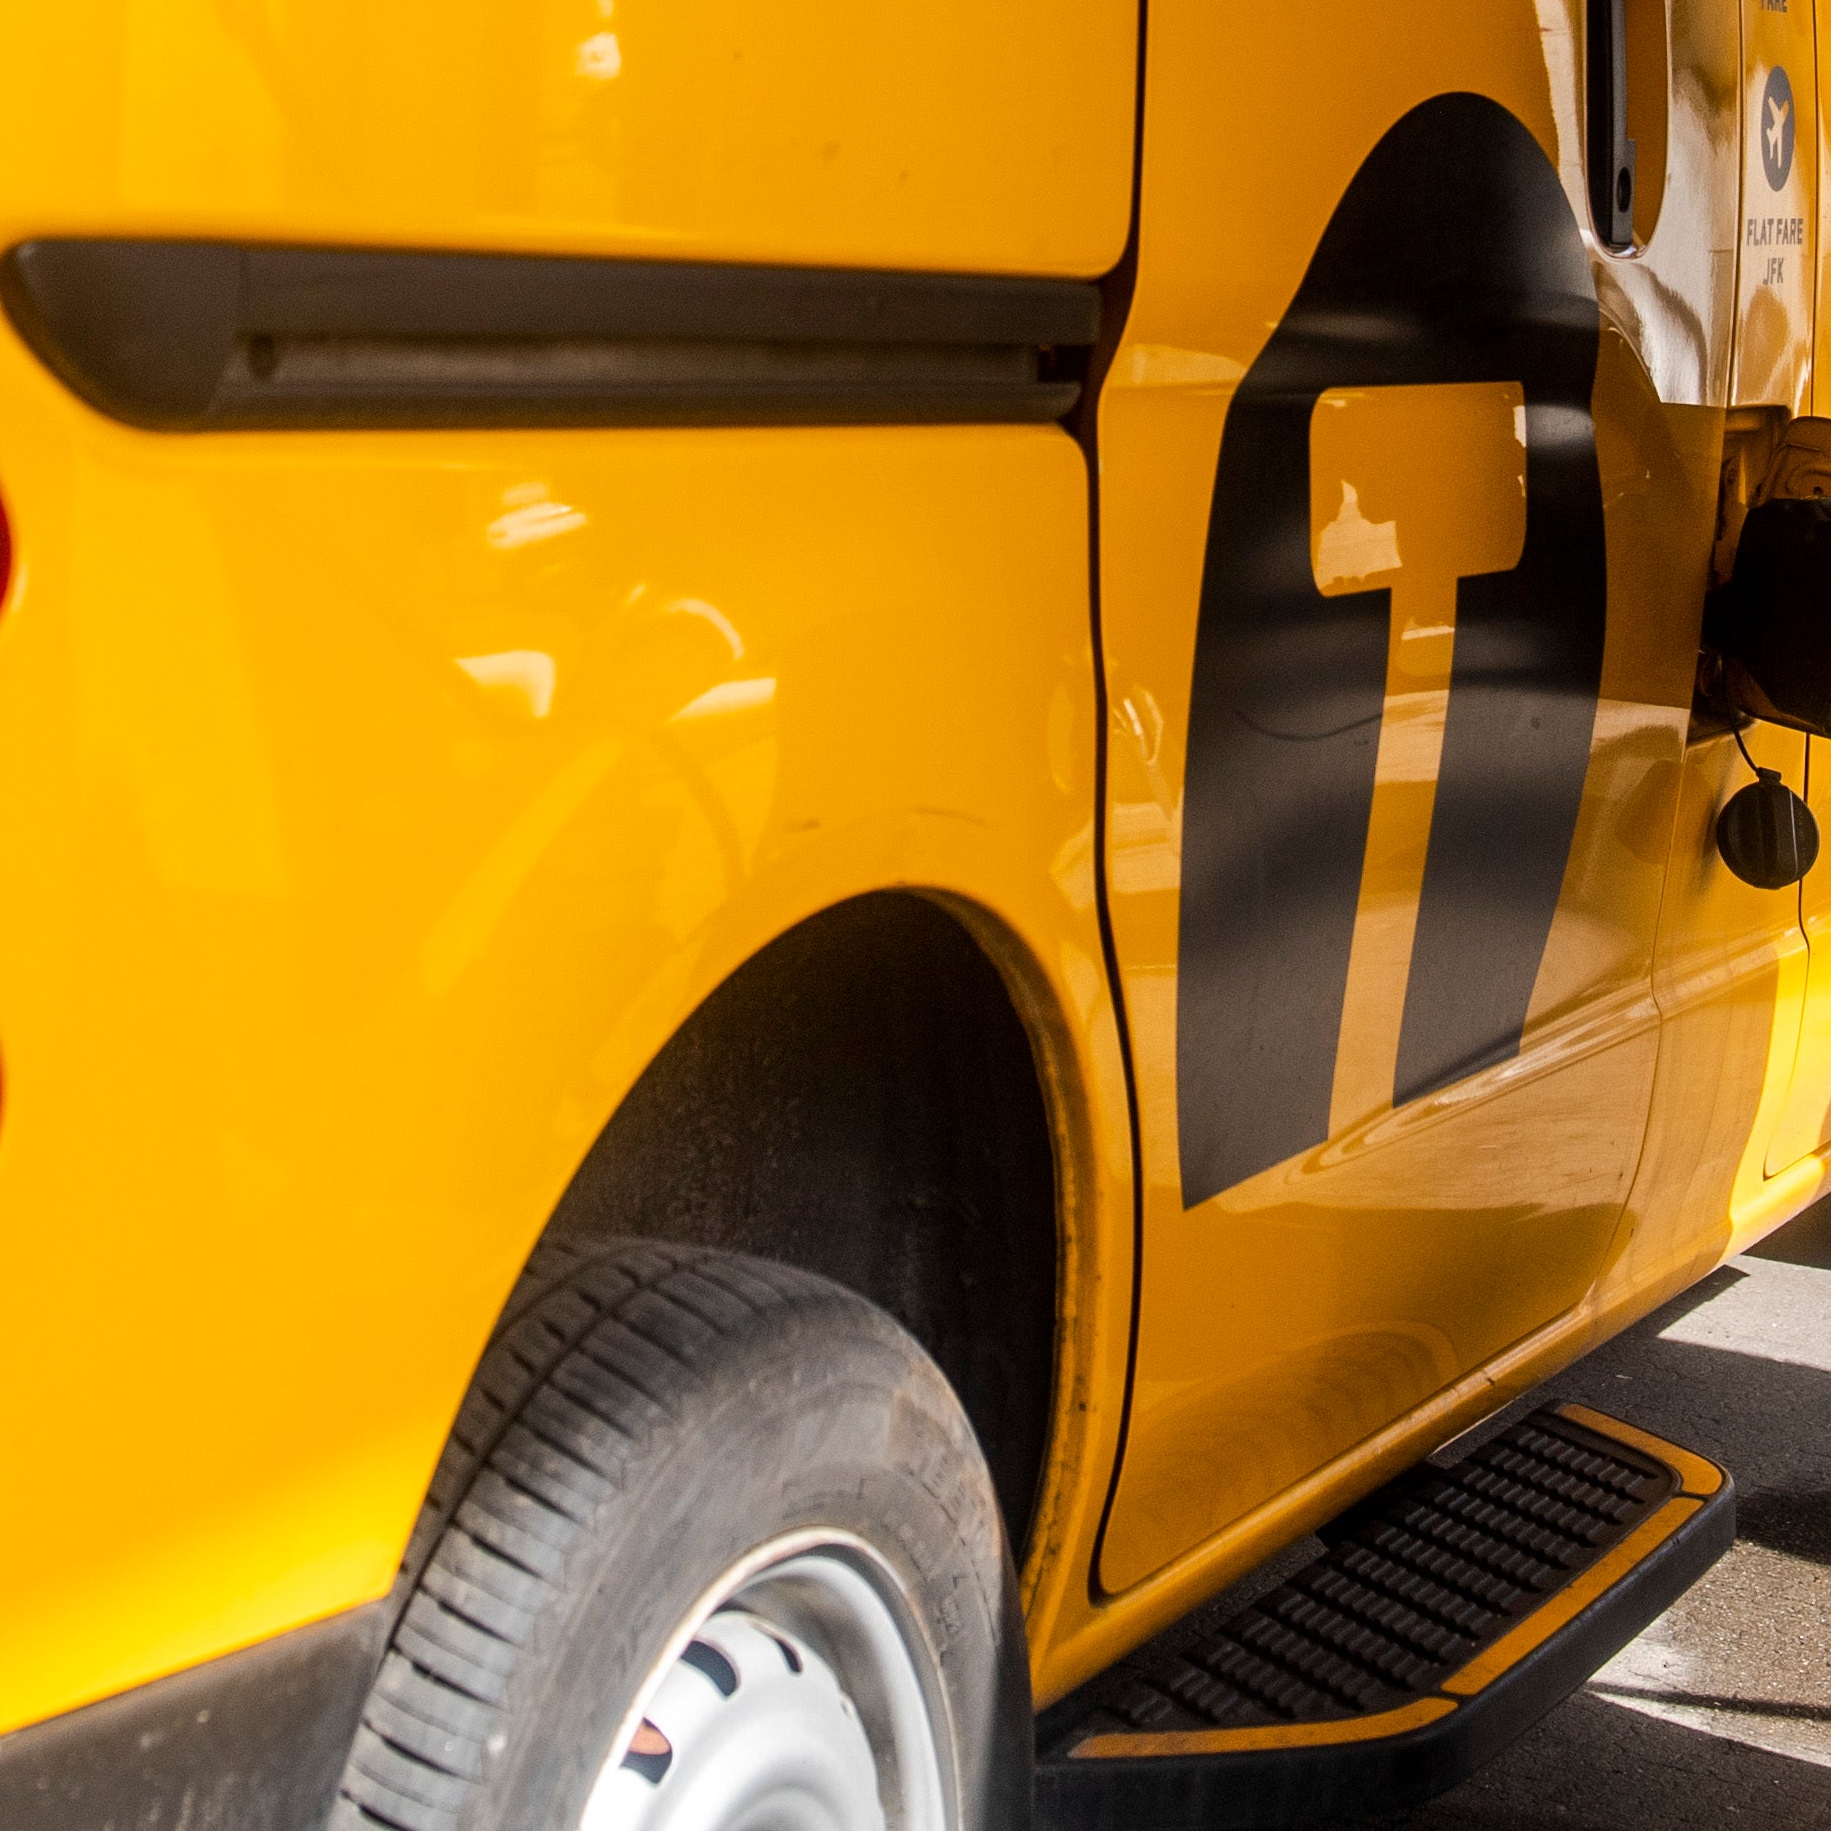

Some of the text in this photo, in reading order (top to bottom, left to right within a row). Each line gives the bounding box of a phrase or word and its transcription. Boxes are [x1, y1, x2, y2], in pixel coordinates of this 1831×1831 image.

[1747, 218, 1804, 246] FLAT FARE
[1763, 257, 1784, 286] JFK
